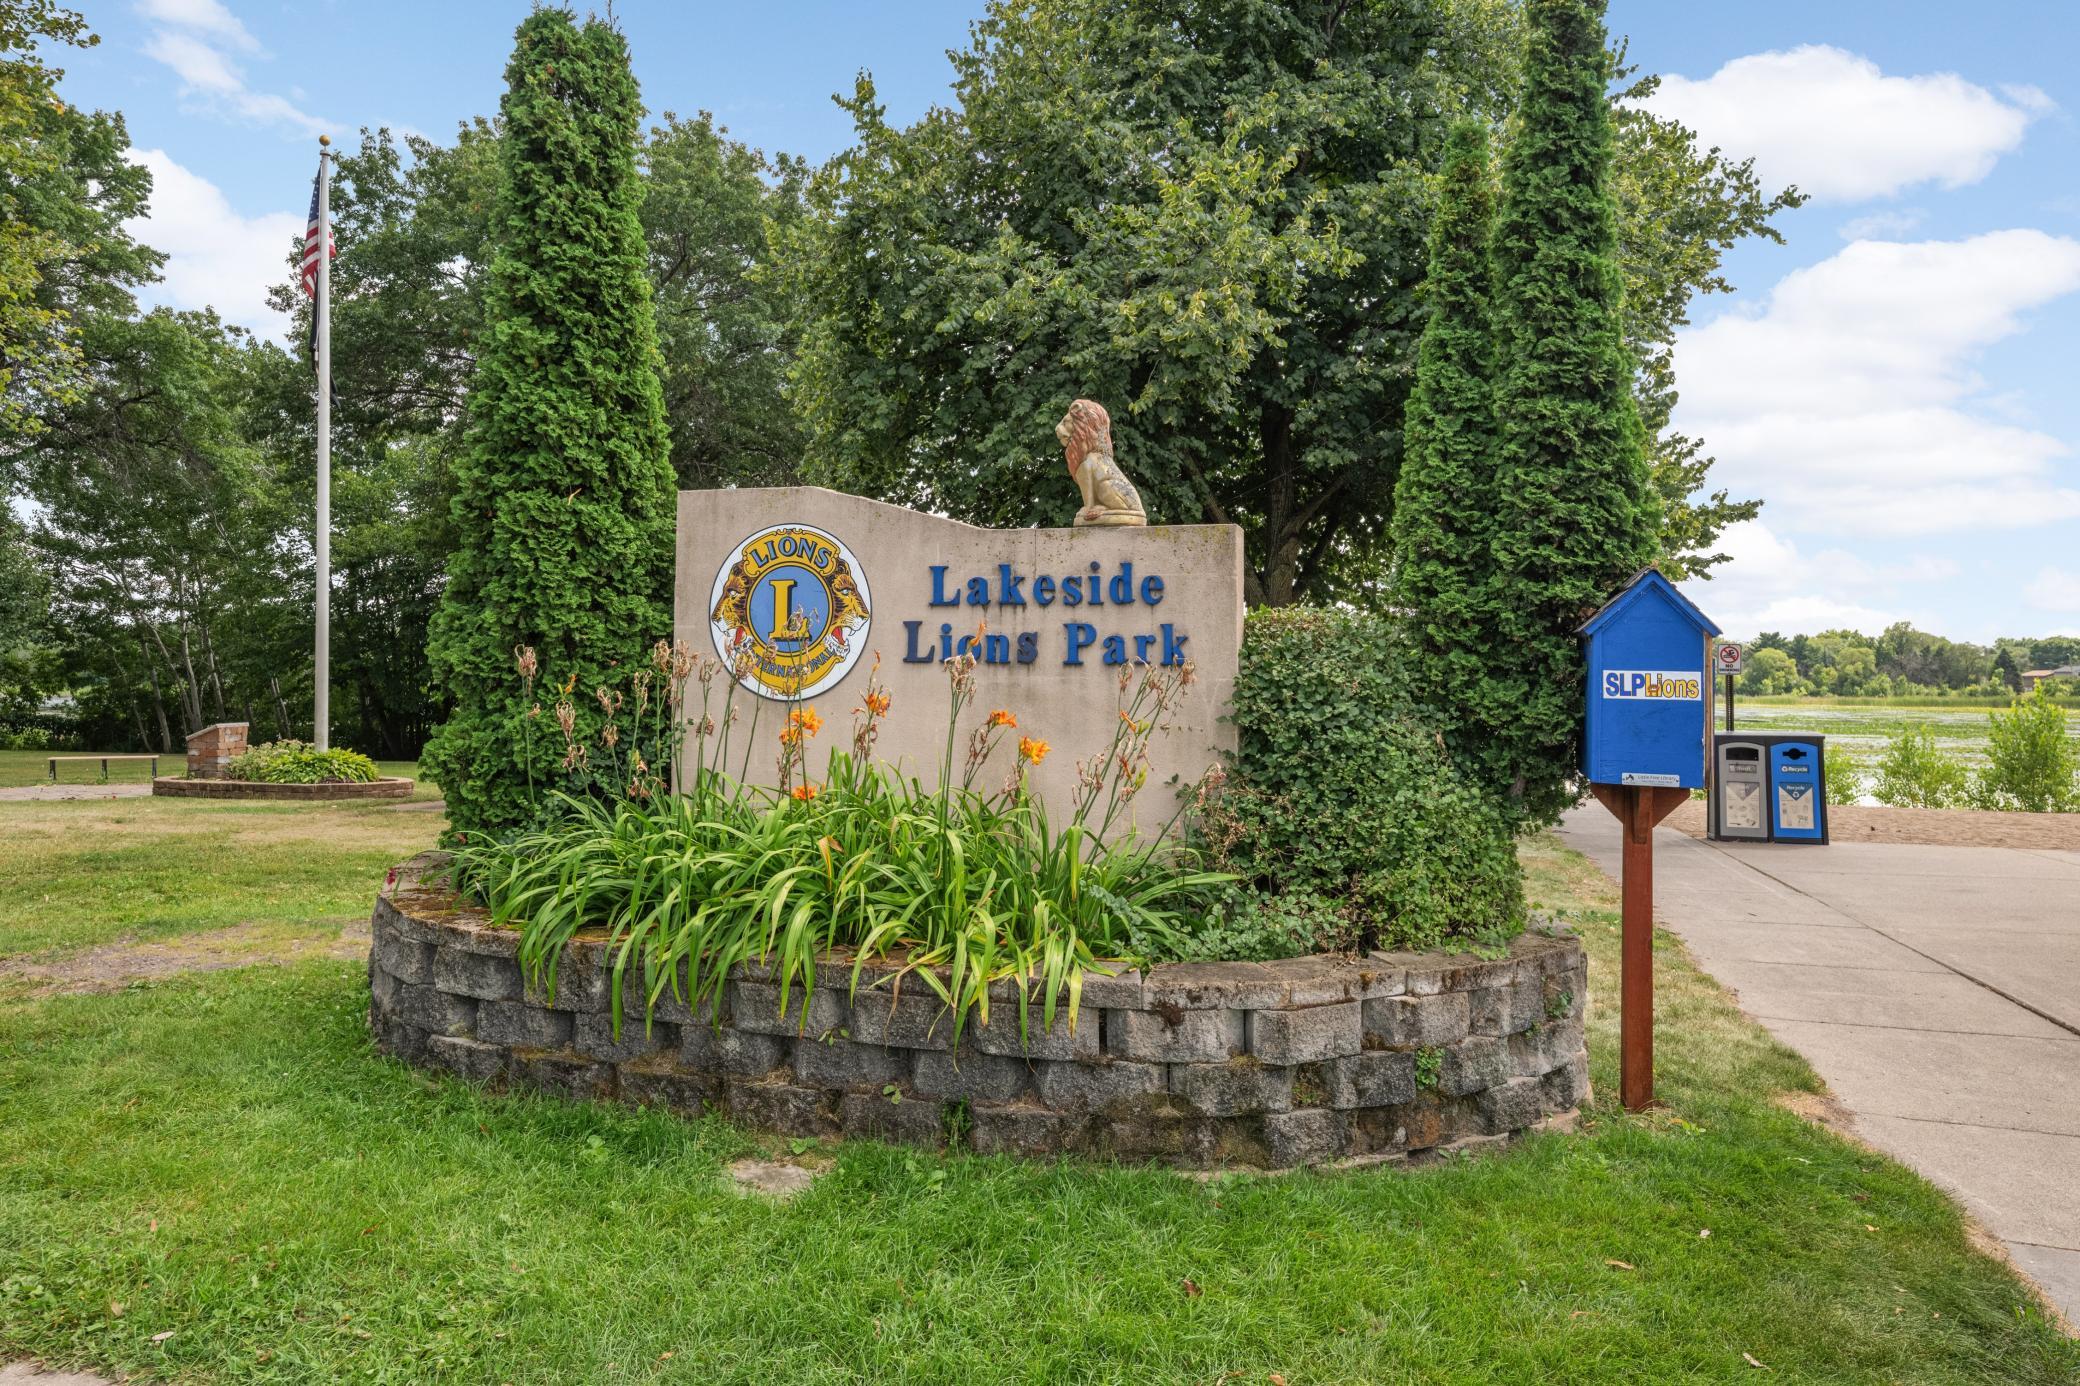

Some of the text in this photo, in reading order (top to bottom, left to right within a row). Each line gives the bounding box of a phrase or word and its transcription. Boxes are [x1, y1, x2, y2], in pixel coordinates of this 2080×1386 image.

[749, 536, 833, 569] LIONS
[928, 560, 1165, 607] Lakeside
[768, 579, 812, 642] L
[902, 620, 1190, 667] Lions Park
